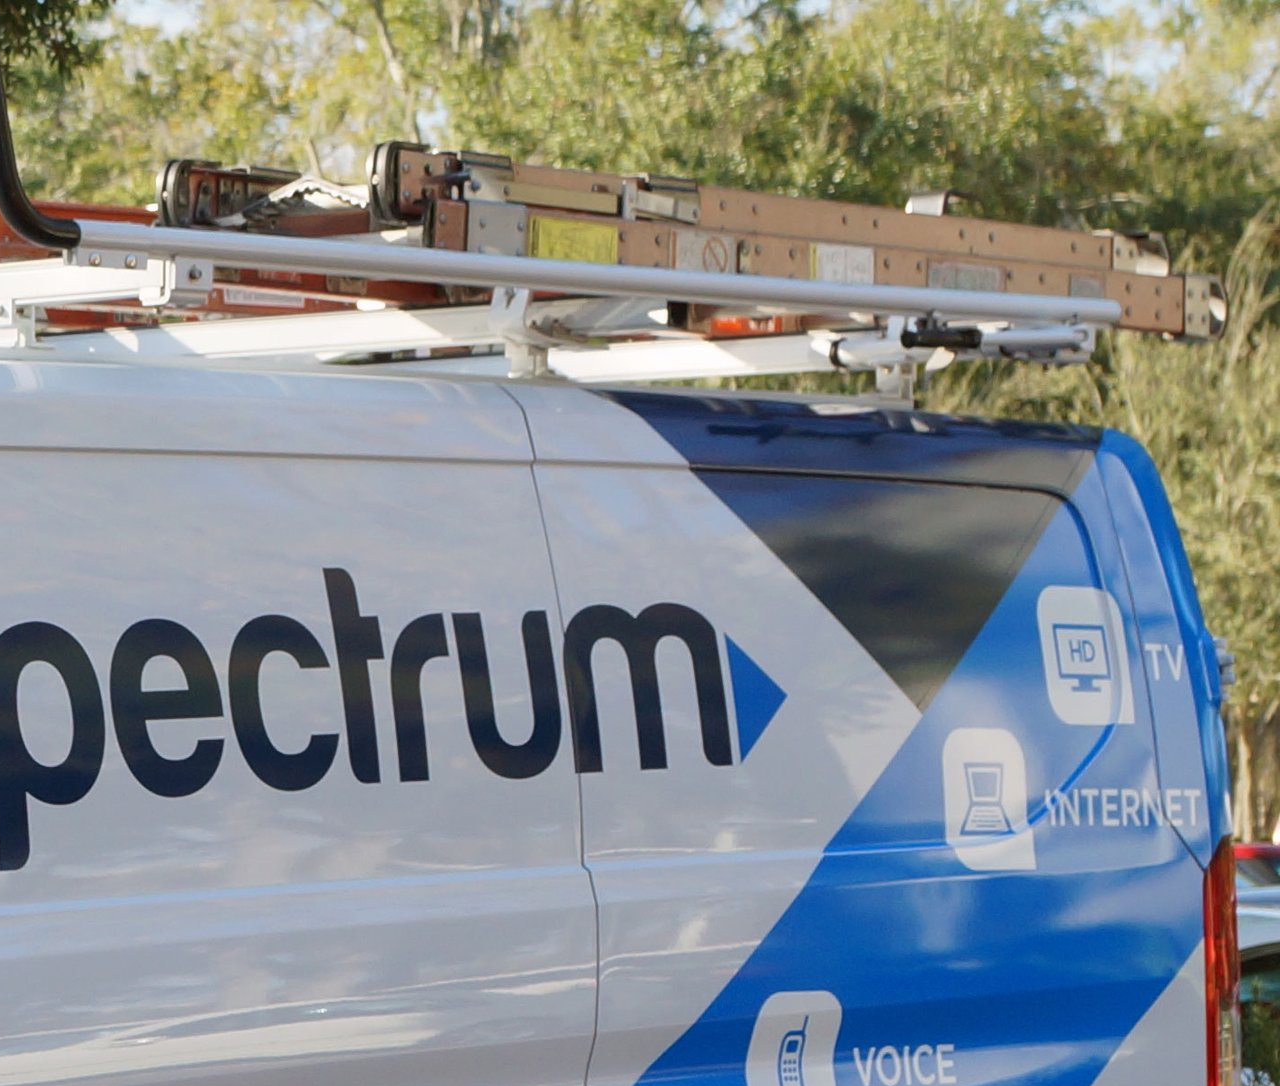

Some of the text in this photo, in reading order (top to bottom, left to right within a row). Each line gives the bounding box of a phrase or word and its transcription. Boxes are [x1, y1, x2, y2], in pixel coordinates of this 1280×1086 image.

[1069, 639, 1095, 663] HD
[1144, 643, 1184, 681] TV
[1044, 788, 1201, 827] INTERNET
